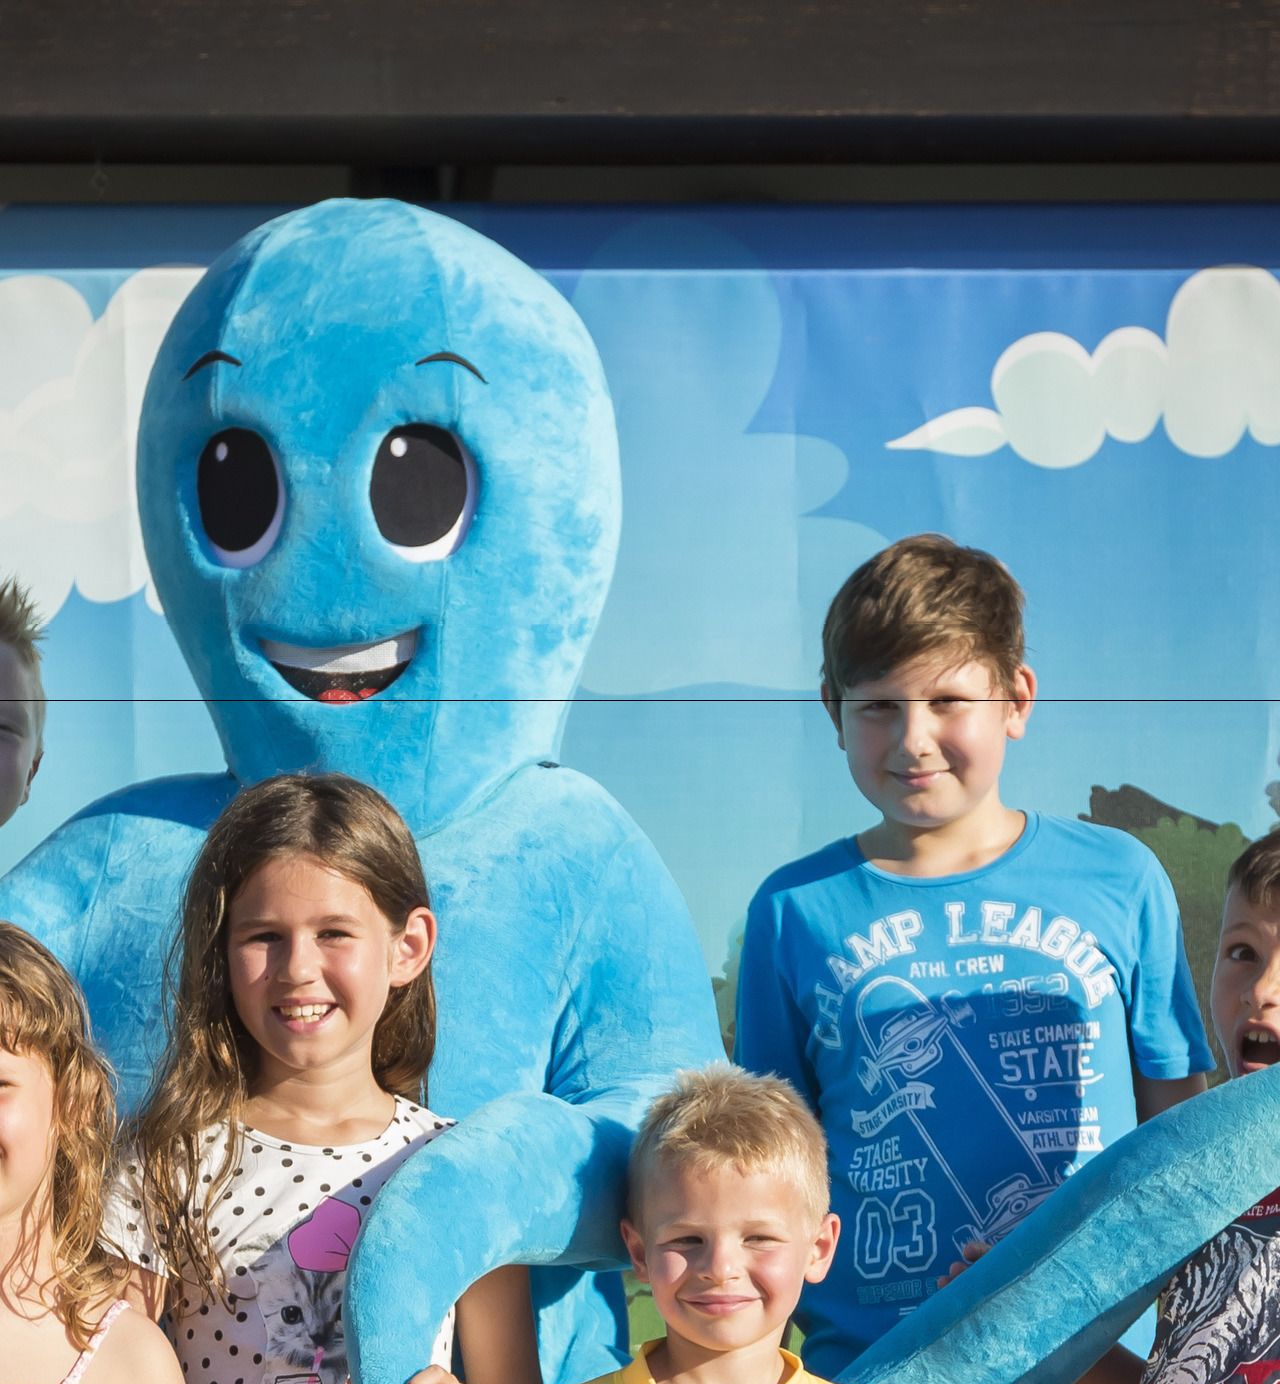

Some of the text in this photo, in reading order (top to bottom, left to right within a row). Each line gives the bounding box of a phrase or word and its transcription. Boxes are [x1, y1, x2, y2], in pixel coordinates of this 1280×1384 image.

[814, 900, 1115, 1050] CHAMP LEAGUE
[909, 954, 1004, 978] ATHL CREW
[989, 1021, 1101, 1049] STATE CHAMPION
[999, 1042, 1095, 1082] STATE
[881, 1092, 922, 1120] VARSITY
[1017, 1106, 1099, 1125] VARSITY TEAM
[849, 1135, 902, 1169] STAGE
[1032, 1129, 1095, 1149] ATHL CREW
[847, 1157, 928, 1193] VARSITY
[854, 1188, 937, 1279] 03
